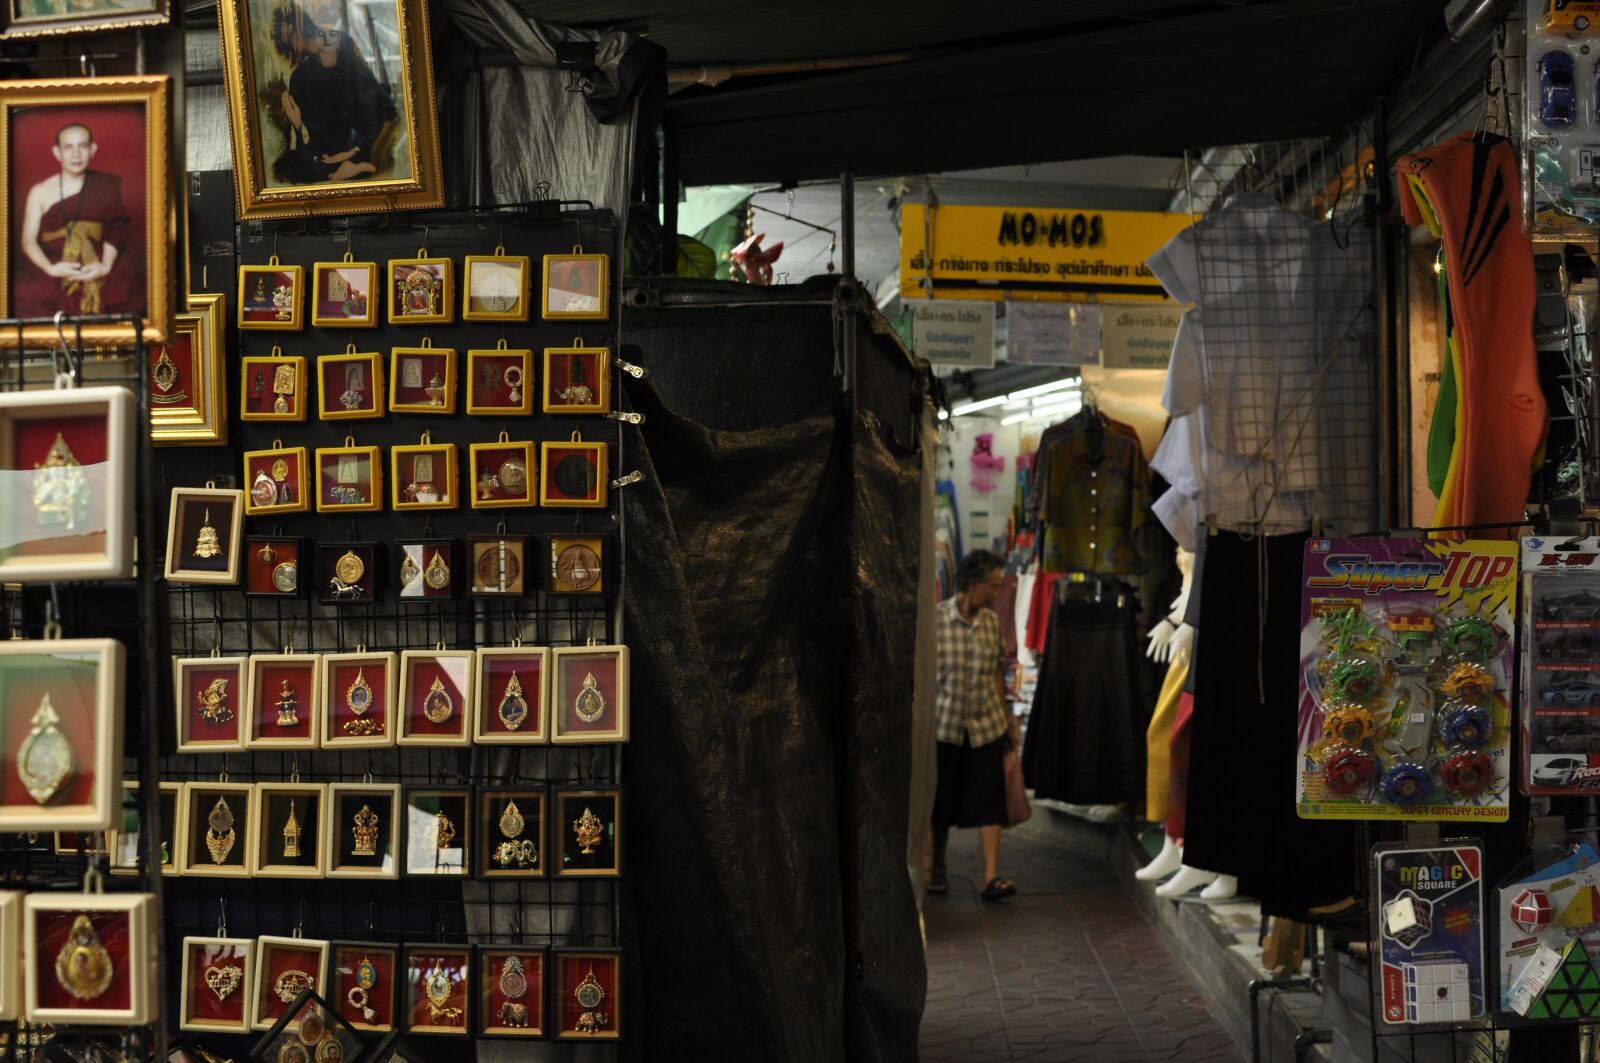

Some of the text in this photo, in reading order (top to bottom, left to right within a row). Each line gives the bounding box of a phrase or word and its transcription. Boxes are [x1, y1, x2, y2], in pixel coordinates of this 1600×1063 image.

[998, 211, 1105, 248] MO-MOS
[995, 256, 1050, 274] กระโปรง
[1307, 550, 1515, 595] Super TOP
[1400, 864, 1463, 890] MAGIC
[1417, 880, 1457, 890] SQUARE
